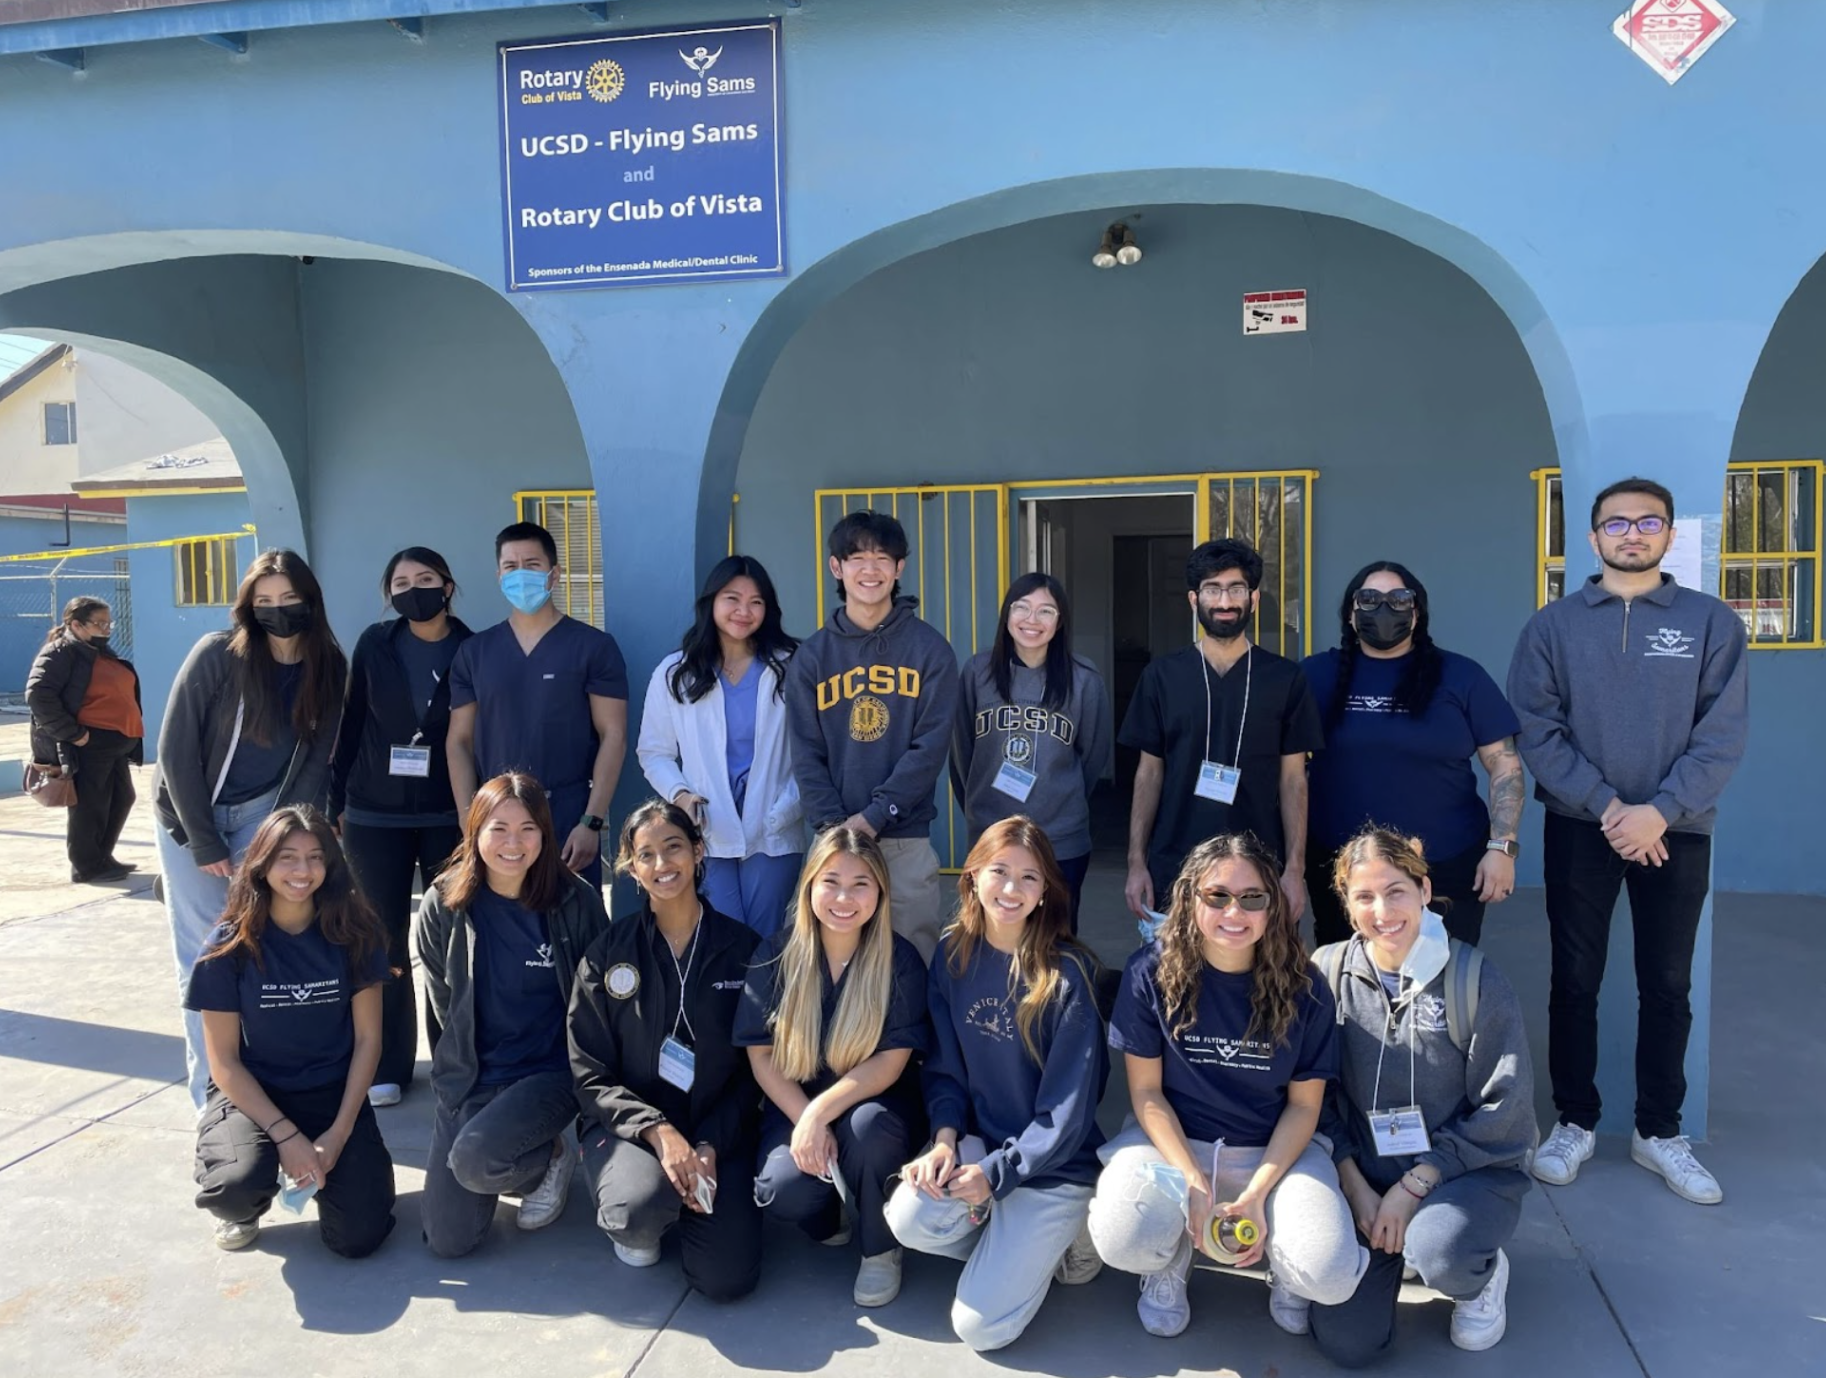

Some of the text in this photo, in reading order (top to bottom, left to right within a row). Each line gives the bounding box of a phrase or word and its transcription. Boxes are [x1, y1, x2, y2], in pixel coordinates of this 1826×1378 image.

[520, 70, 584, 90] Rotary
[649, 76, 756, 101] Flying Sams
[521, 90, 582, 105] Club of Vista
[521, 133, 589, 157] UCSD
[609, 127, 686, 155] Flying
[692, 122, 758, 144] Sams
[623, 166, 655, 183] and
[521, 194, 763, 229] Rotary Club of Vista
[528, 254, 759, 279] Sponsors of the Ensenada Medical/Dental Clinic
[816, 664, 920, 711] UCSD
[975, 705, 1074, 746] UCSD
[1204, 1036, 1228, 1045] FLYING
